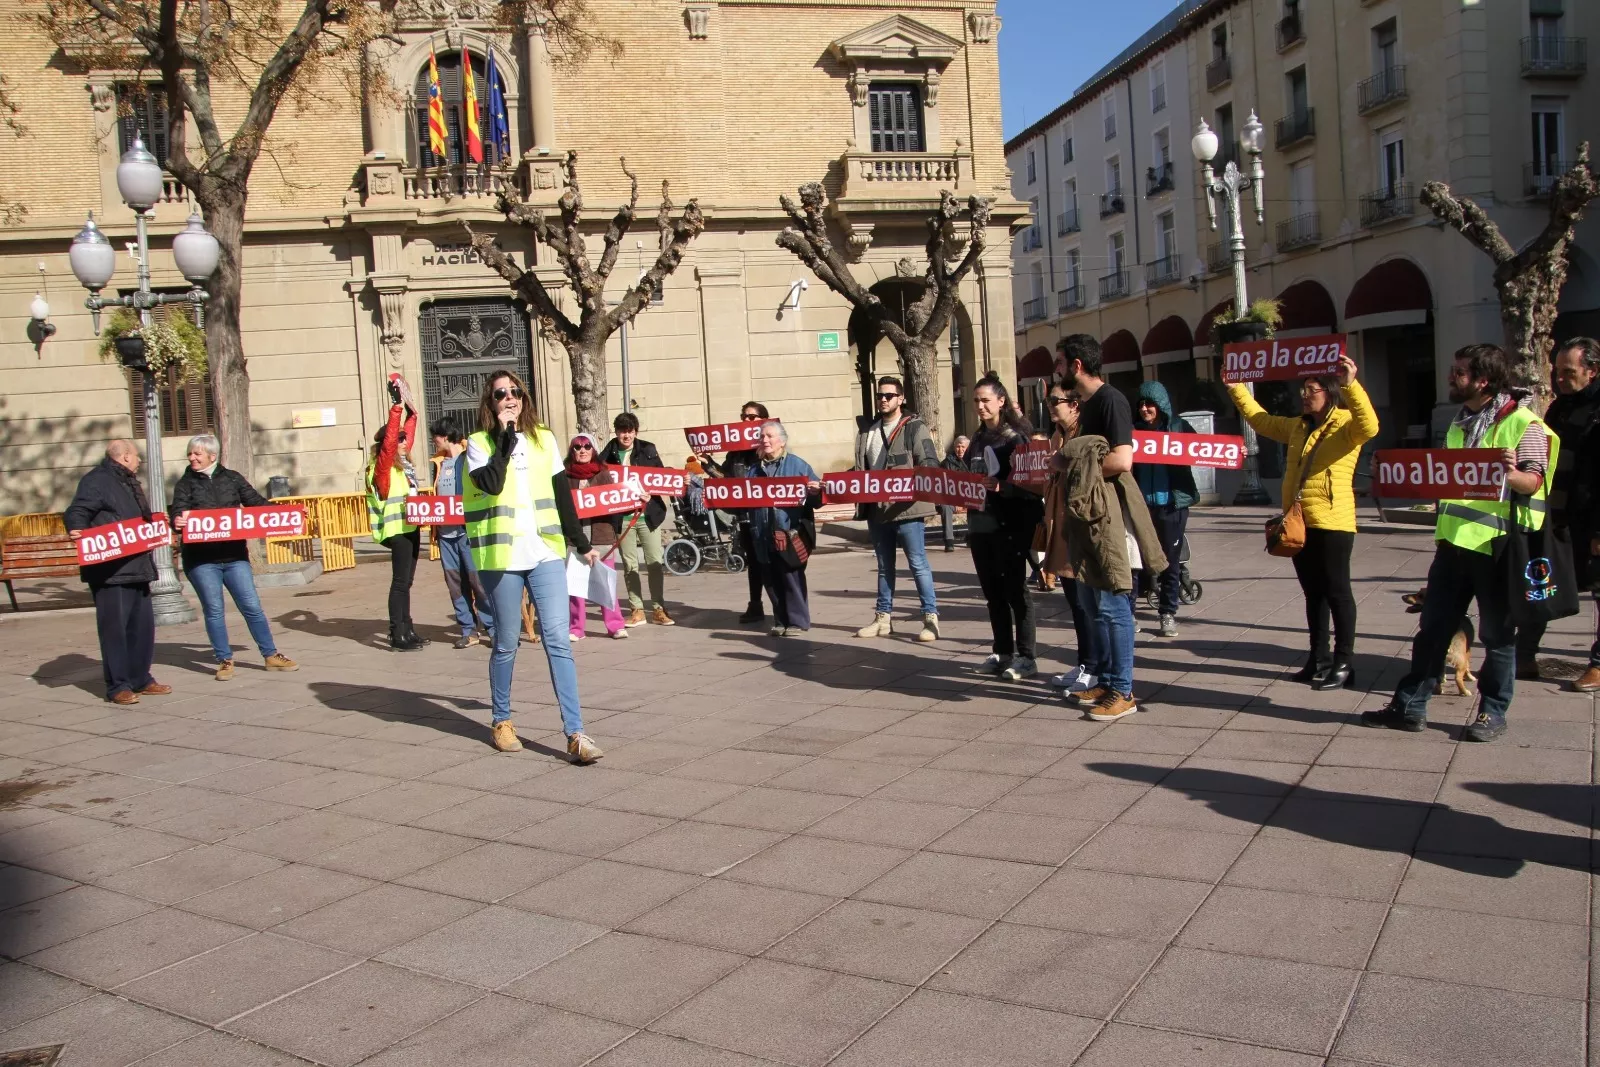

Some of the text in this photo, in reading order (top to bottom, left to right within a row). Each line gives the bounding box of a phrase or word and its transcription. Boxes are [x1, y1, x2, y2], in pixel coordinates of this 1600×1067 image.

[1226, 341, 1340, 371] no a la caza
[1226, 369, 1264, 381] con perros
[688, 425, 761, 446] no a la ca
[1131, 434, 1239, 460] o a la caza
[623, 466, 640, 486] la
[643, 472, 683, 488] caza
[1379, 453, 1504, 486] no a la caza
[705, 480, 806, 500] no a la caza
[825, 473, 914, 495] no a la caz
[914, 472, 987, 500] no a la caza
[406, 496, 465, 516] no a la
[576, 489, 596, 509] la
[187, 508, 302, 532] no a la caza
[420, 516, 445, 524] perros
[81, 533, 108, 554] no
[108, 531, 120, 548] a
[117, 523, 137, 545] la
[137, 519, 167, 540] caza
[187, 530, 231, 540] con perros
[83, 547, 122, 562] con perros
